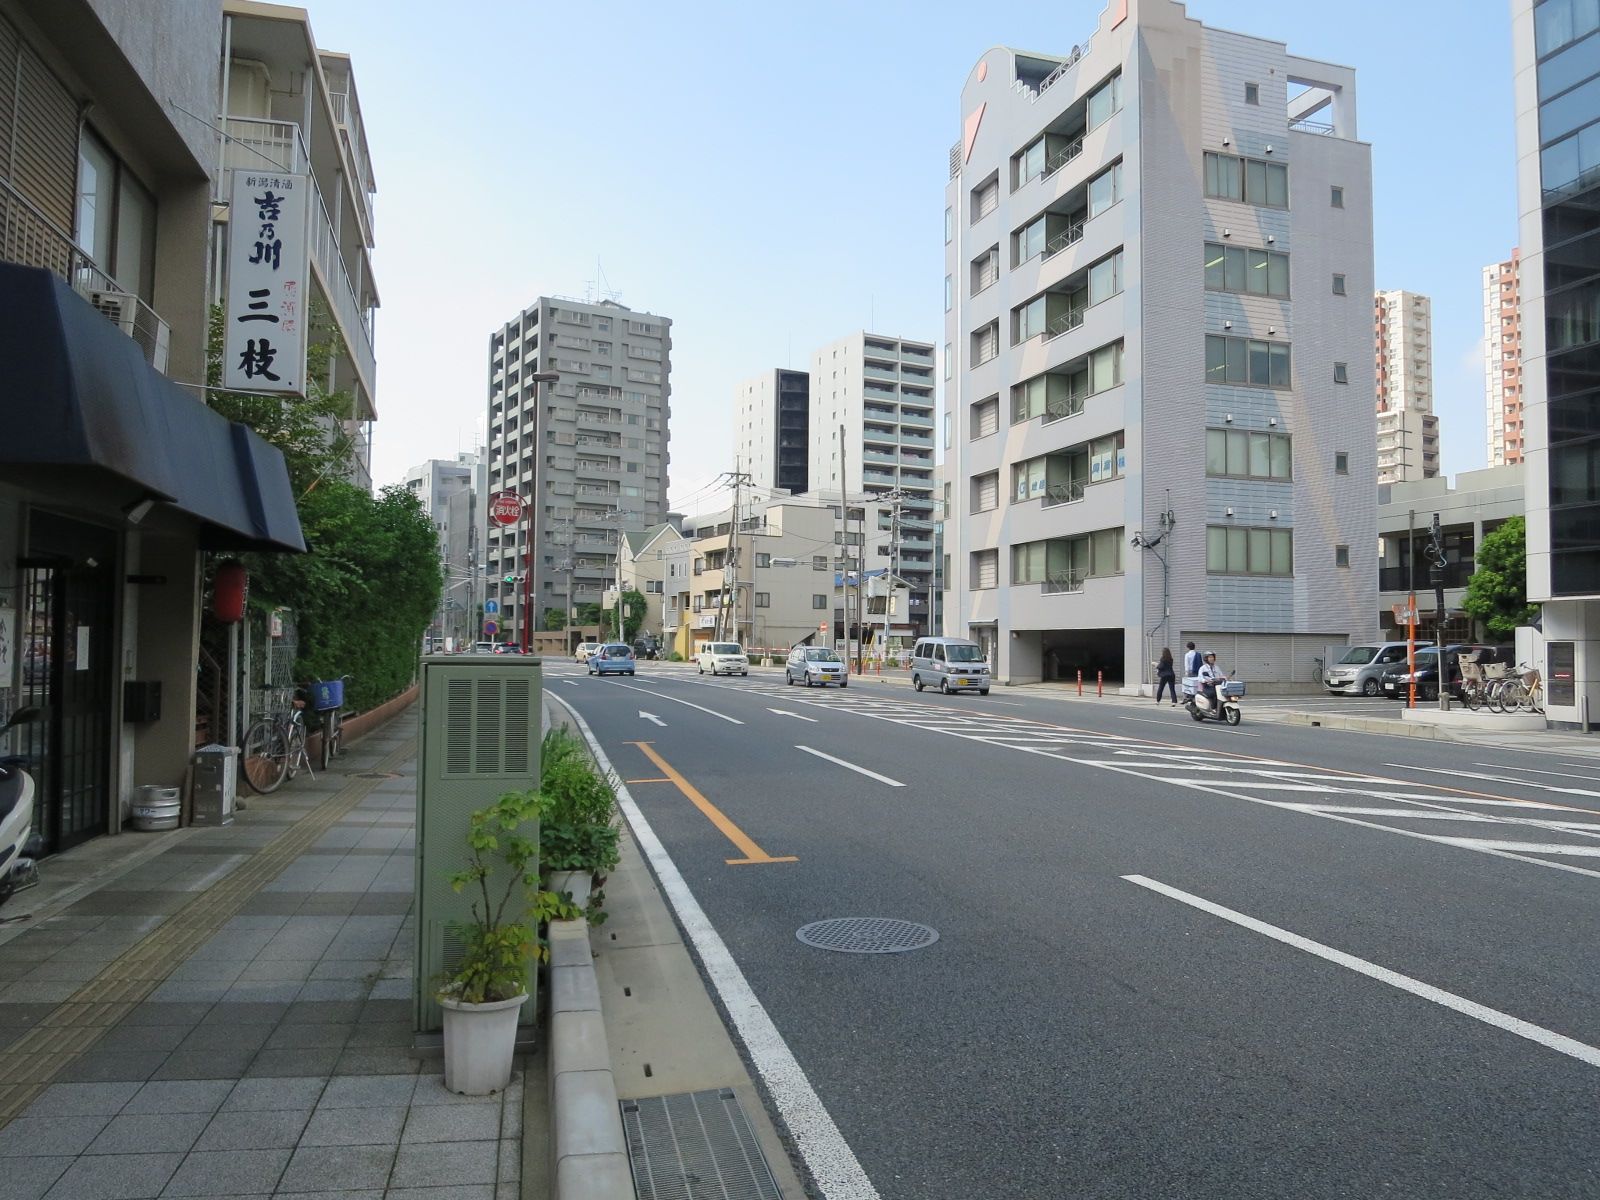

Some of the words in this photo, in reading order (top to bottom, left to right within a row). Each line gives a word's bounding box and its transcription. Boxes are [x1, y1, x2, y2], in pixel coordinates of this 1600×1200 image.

[246, 177, 293, 190] 新潟清酒
[249, 191, 285, 271] 吉乃川
[237, 288, 280, 382] 三枝
[495, 505, 520, 517] 消火栓
